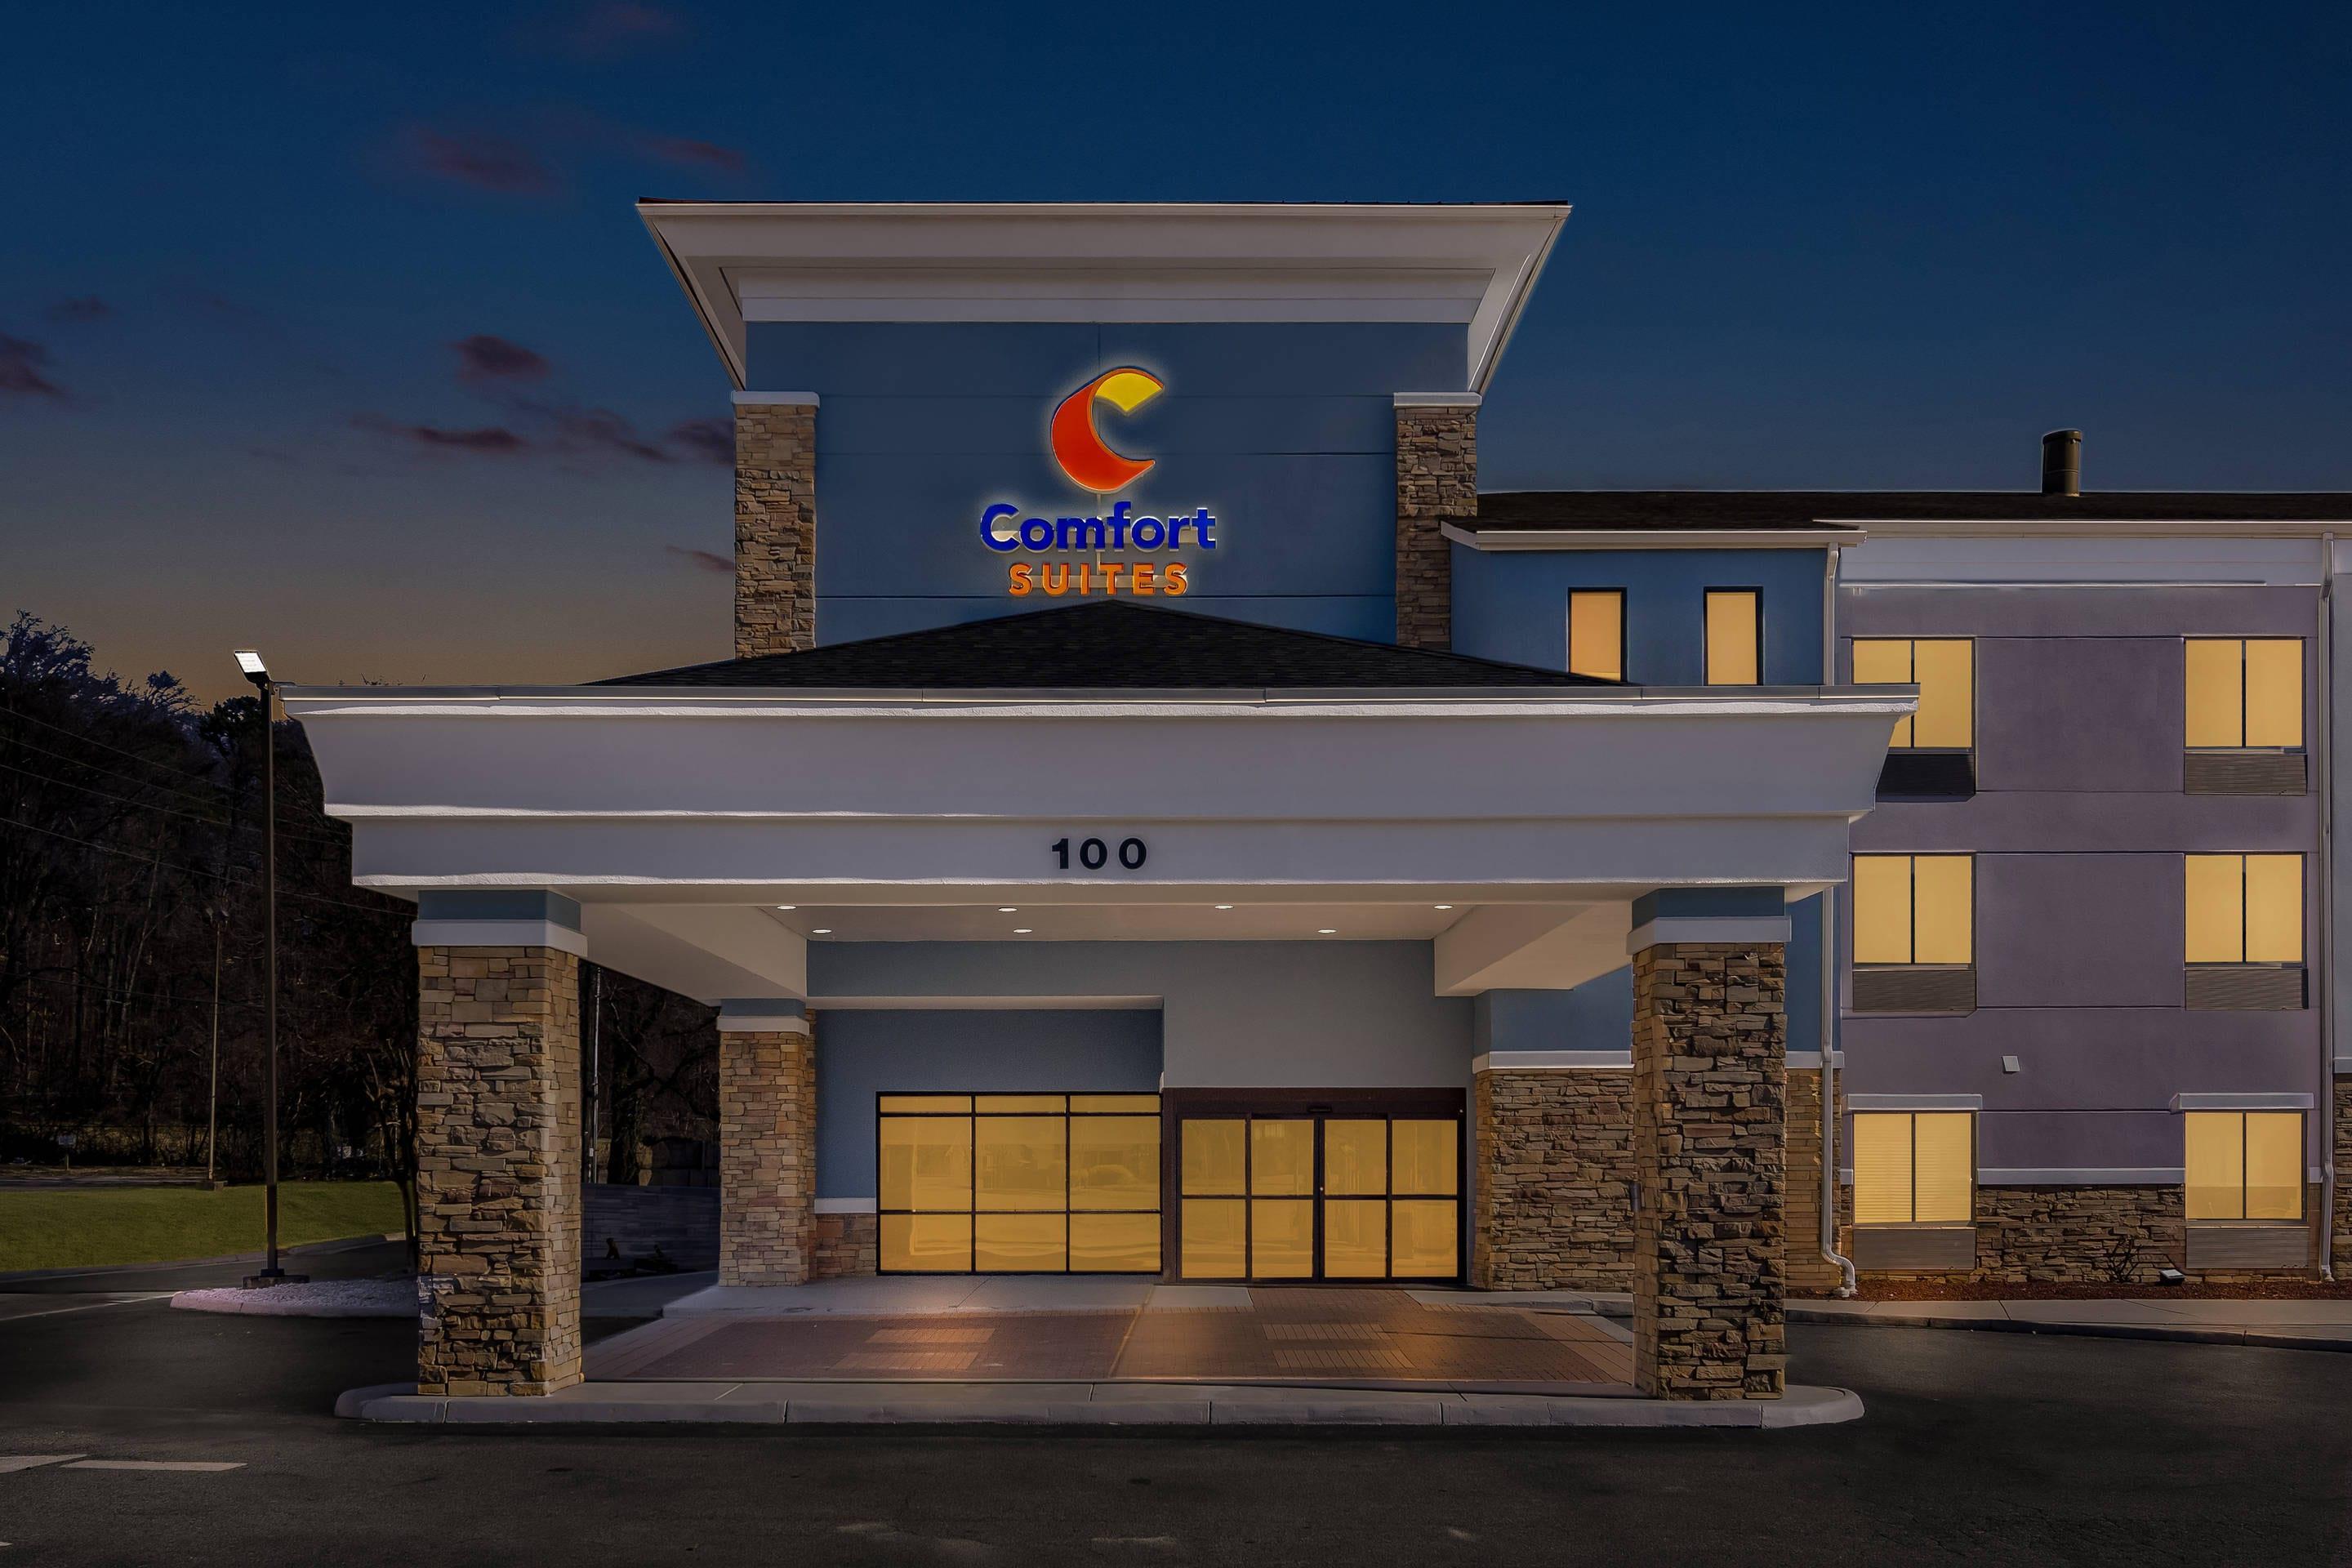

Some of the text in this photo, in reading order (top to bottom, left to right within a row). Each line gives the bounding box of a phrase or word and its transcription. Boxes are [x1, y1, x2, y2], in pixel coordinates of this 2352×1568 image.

[981, 501, 1216, 551] Comfort
[1009, 563, 1187, 595] SUITES
[1052, 838, 1147, 870] 100
